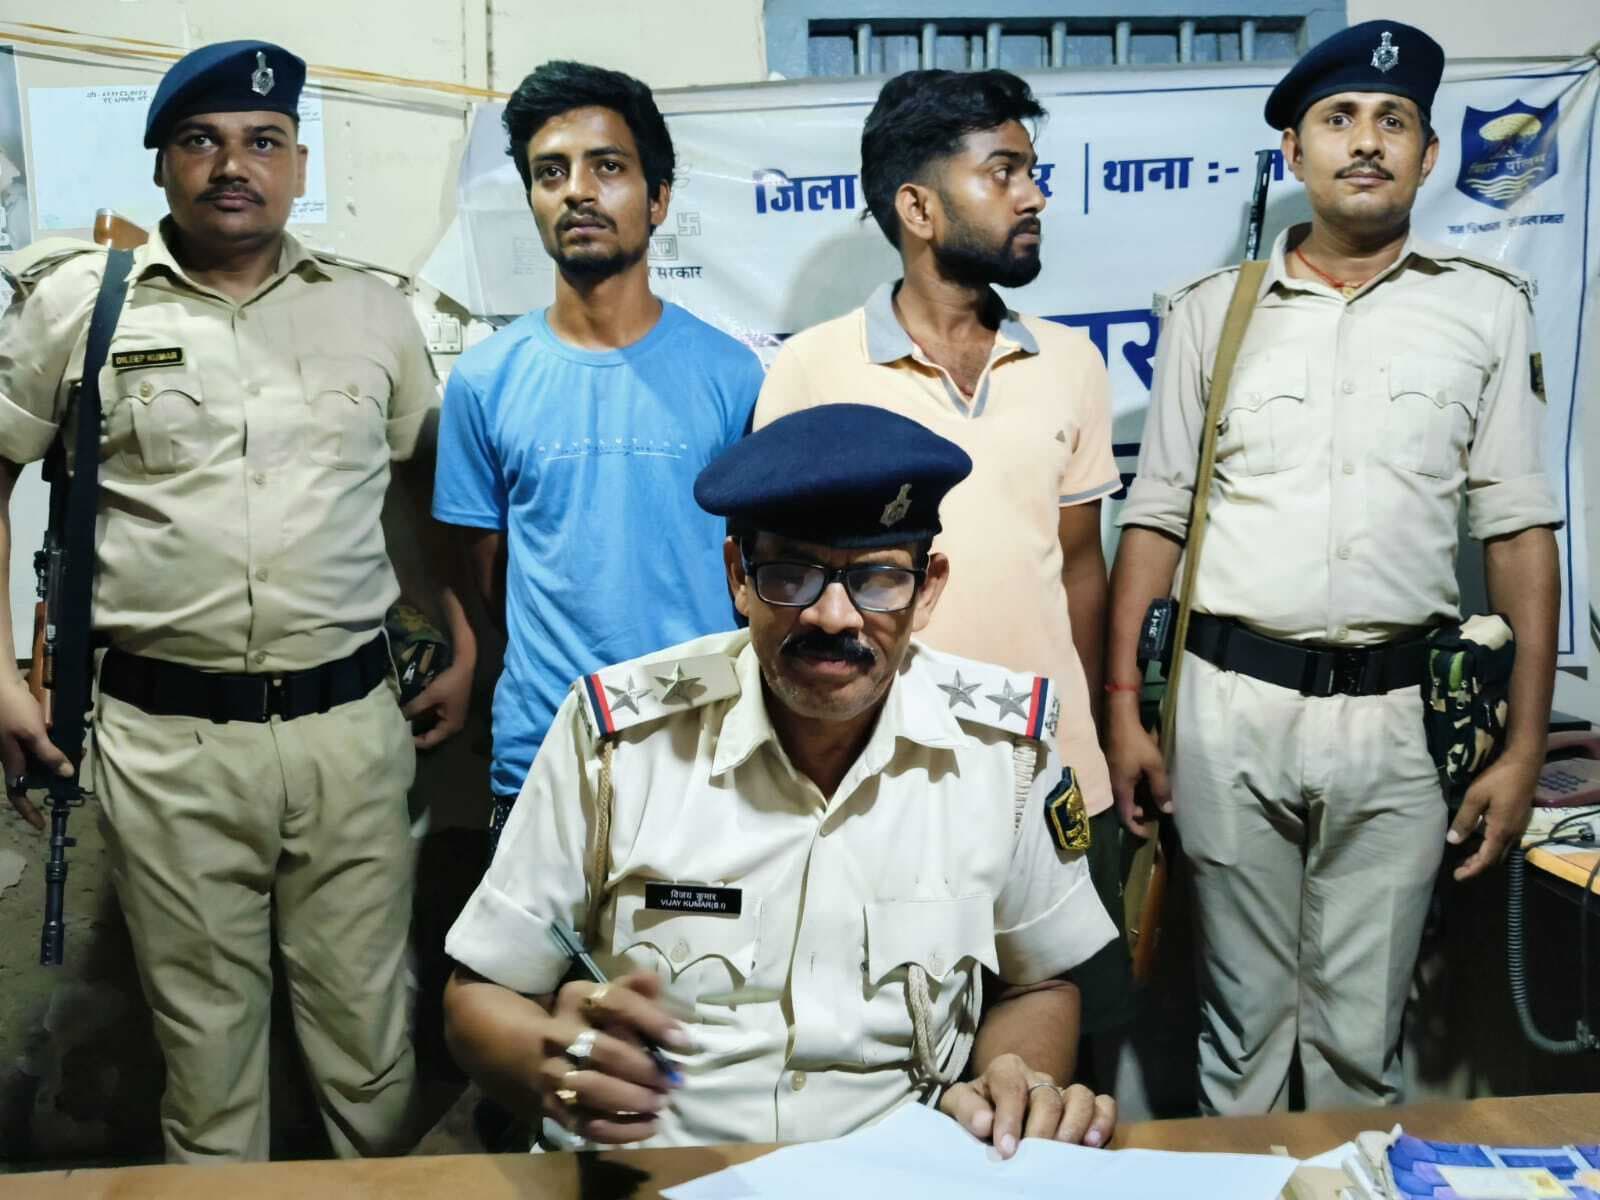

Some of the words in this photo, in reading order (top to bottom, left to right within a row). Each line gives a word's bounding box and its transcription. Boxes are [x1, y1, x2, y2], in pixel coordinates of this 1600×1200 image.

[1103, 157, 1194, 193] थाना
[753, 168, 858, 214] जिला
[656, 265, 703, 280] सरकार
[660, 899, 682, 907] VIJAY
